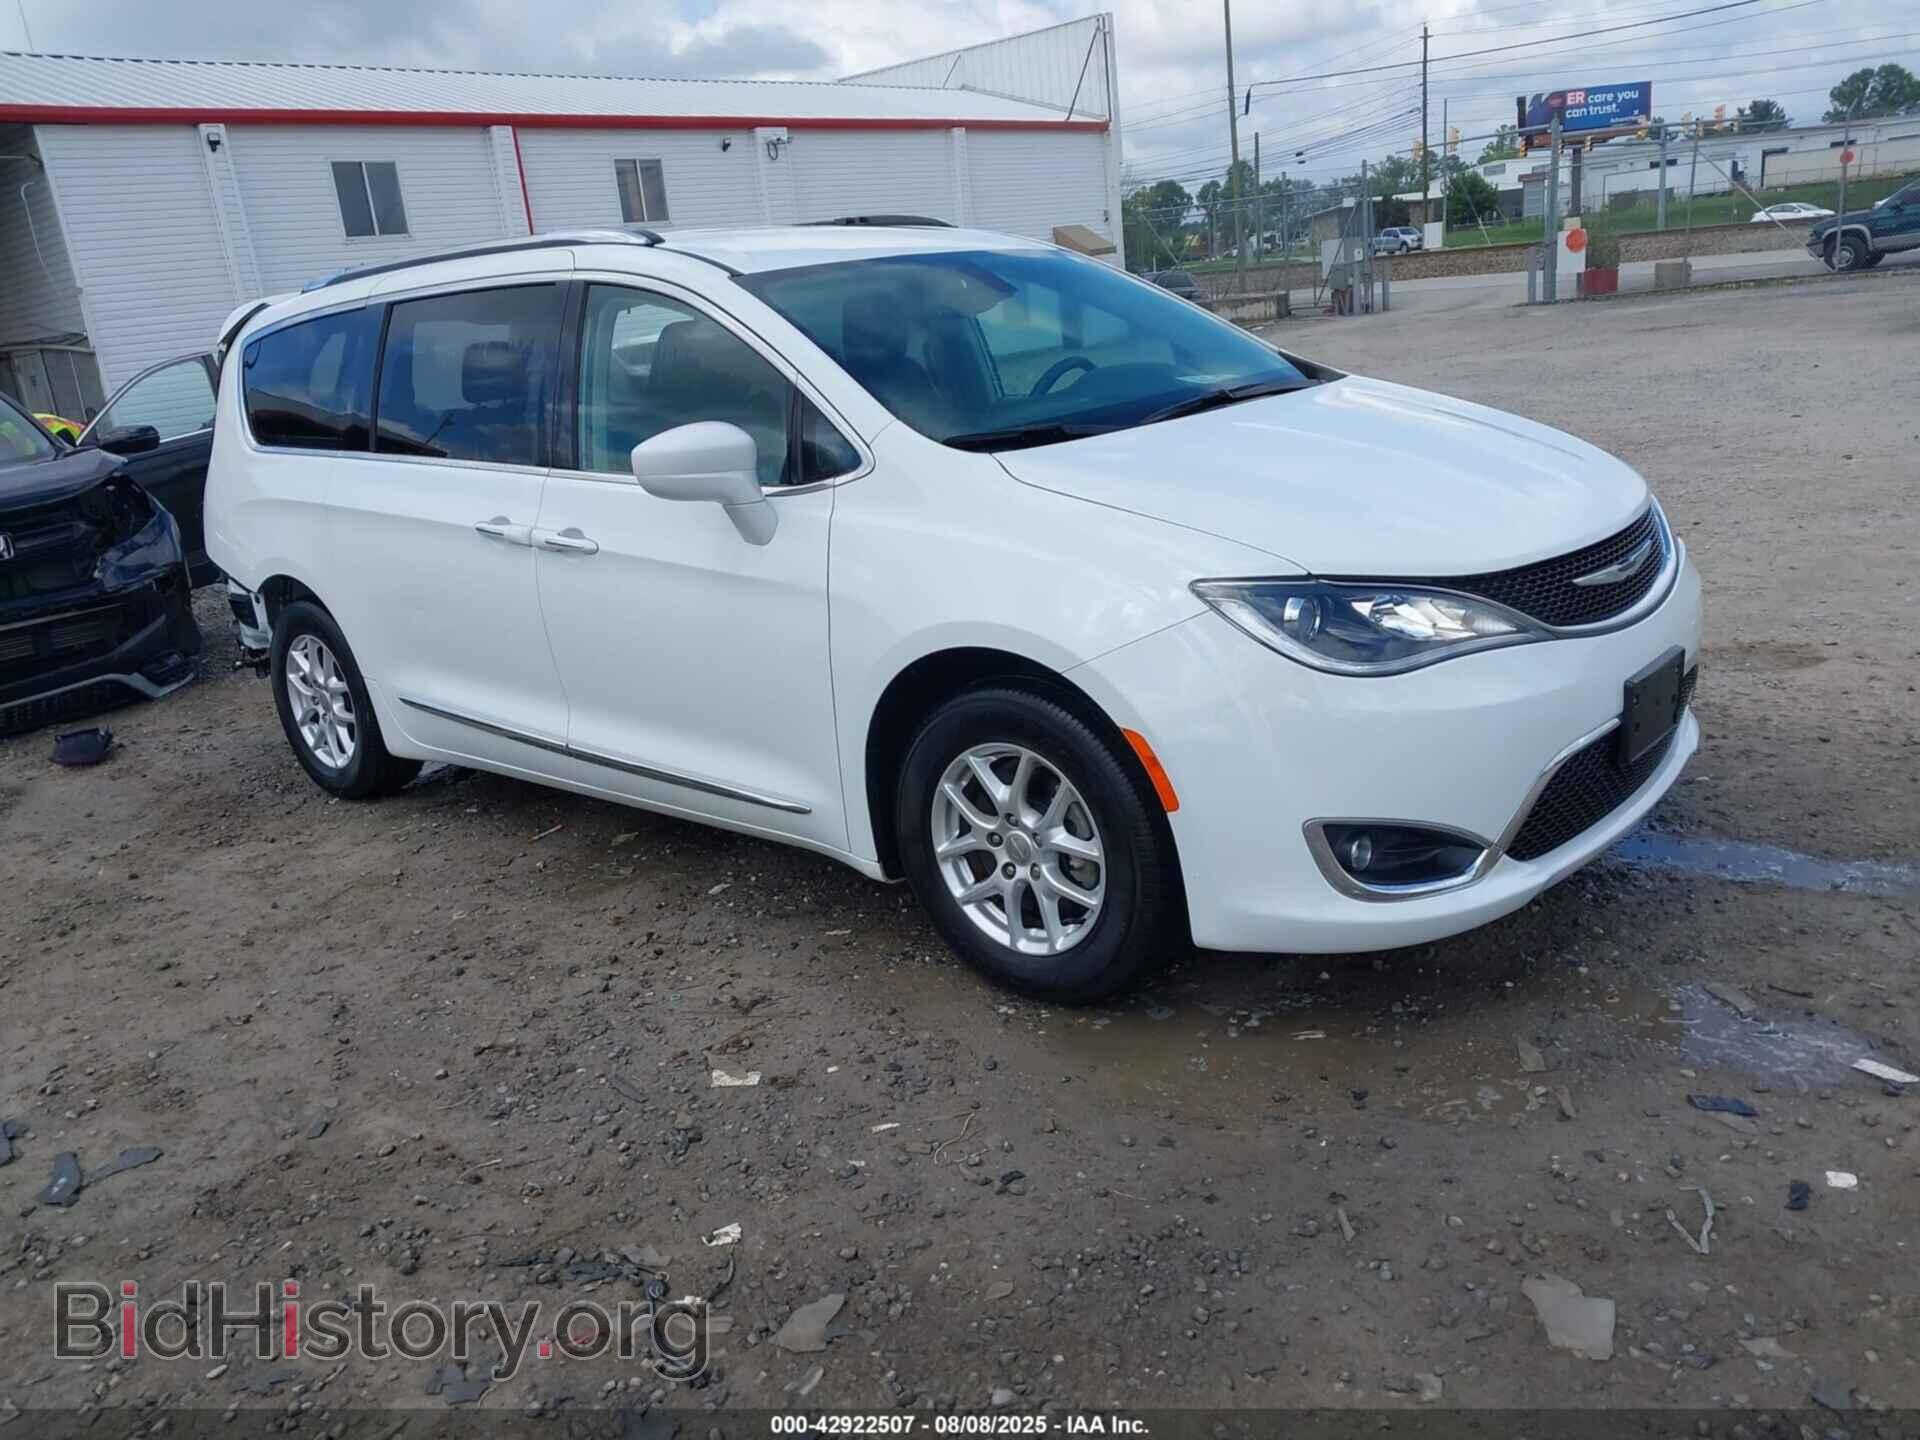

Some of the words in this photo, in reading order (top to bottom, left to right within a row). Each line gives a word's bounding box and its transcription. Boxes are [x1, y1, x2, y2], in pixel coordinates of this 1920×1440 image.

[1567, 91, 1585, 105] ER
[1587, 92, 1614, 103] care
[1616, 89, 1639, 103] you
[1565, 107, 1587, 118] can
[1589, 103, 1620, 115] trust.
